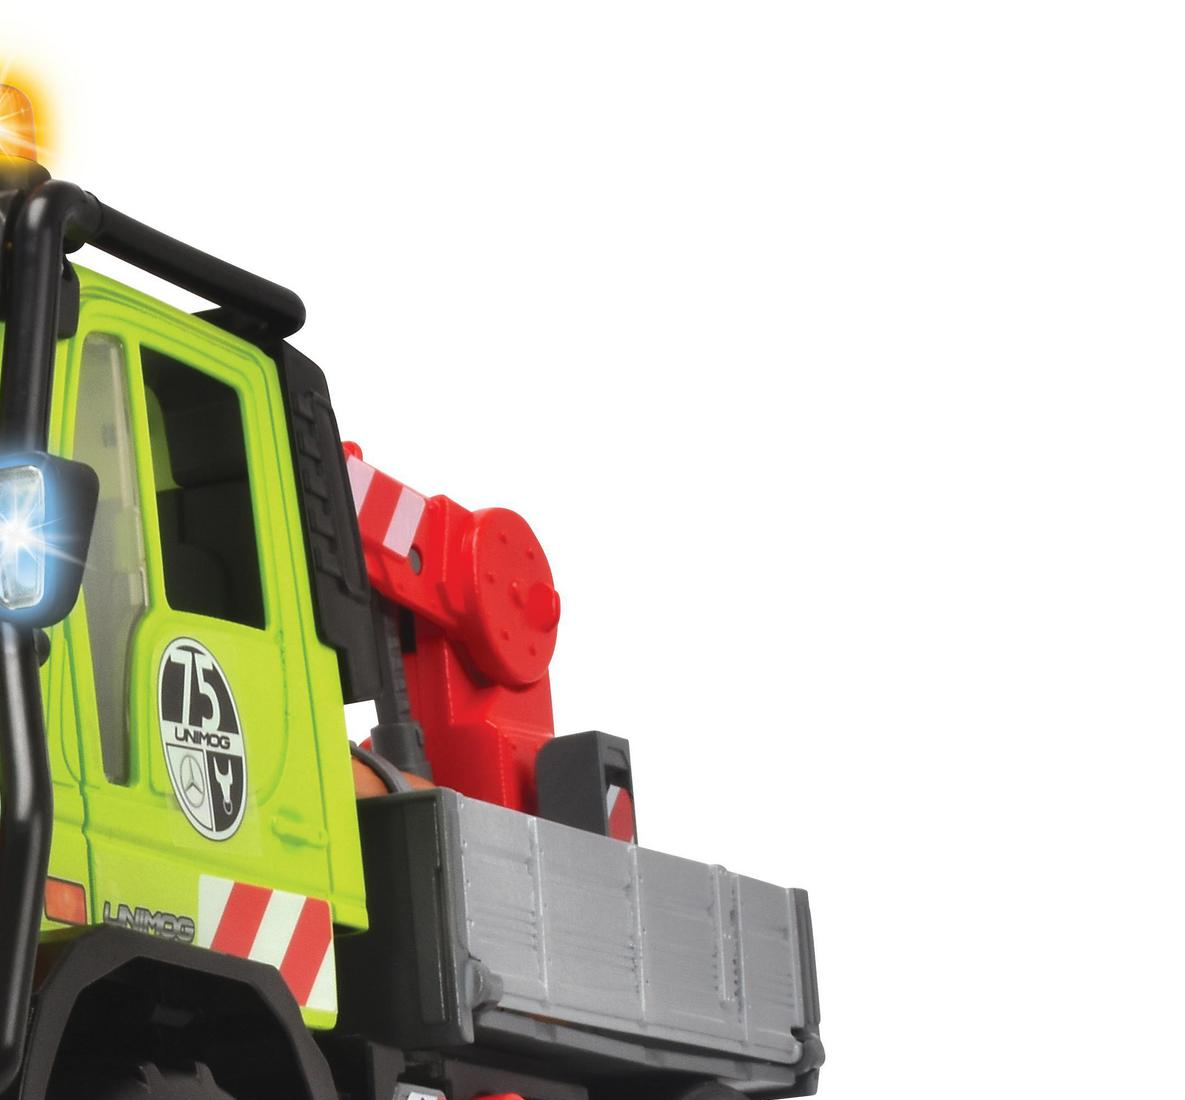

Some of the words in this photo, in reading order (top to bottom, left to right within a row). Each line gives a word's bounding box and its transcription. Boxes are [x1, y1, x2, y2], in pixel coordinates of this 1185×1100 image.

[170, 651, 222, 733] 75
[174, 726, 231, 750] UNIMOG
[103, 900, 195, 943] UNIMOG
